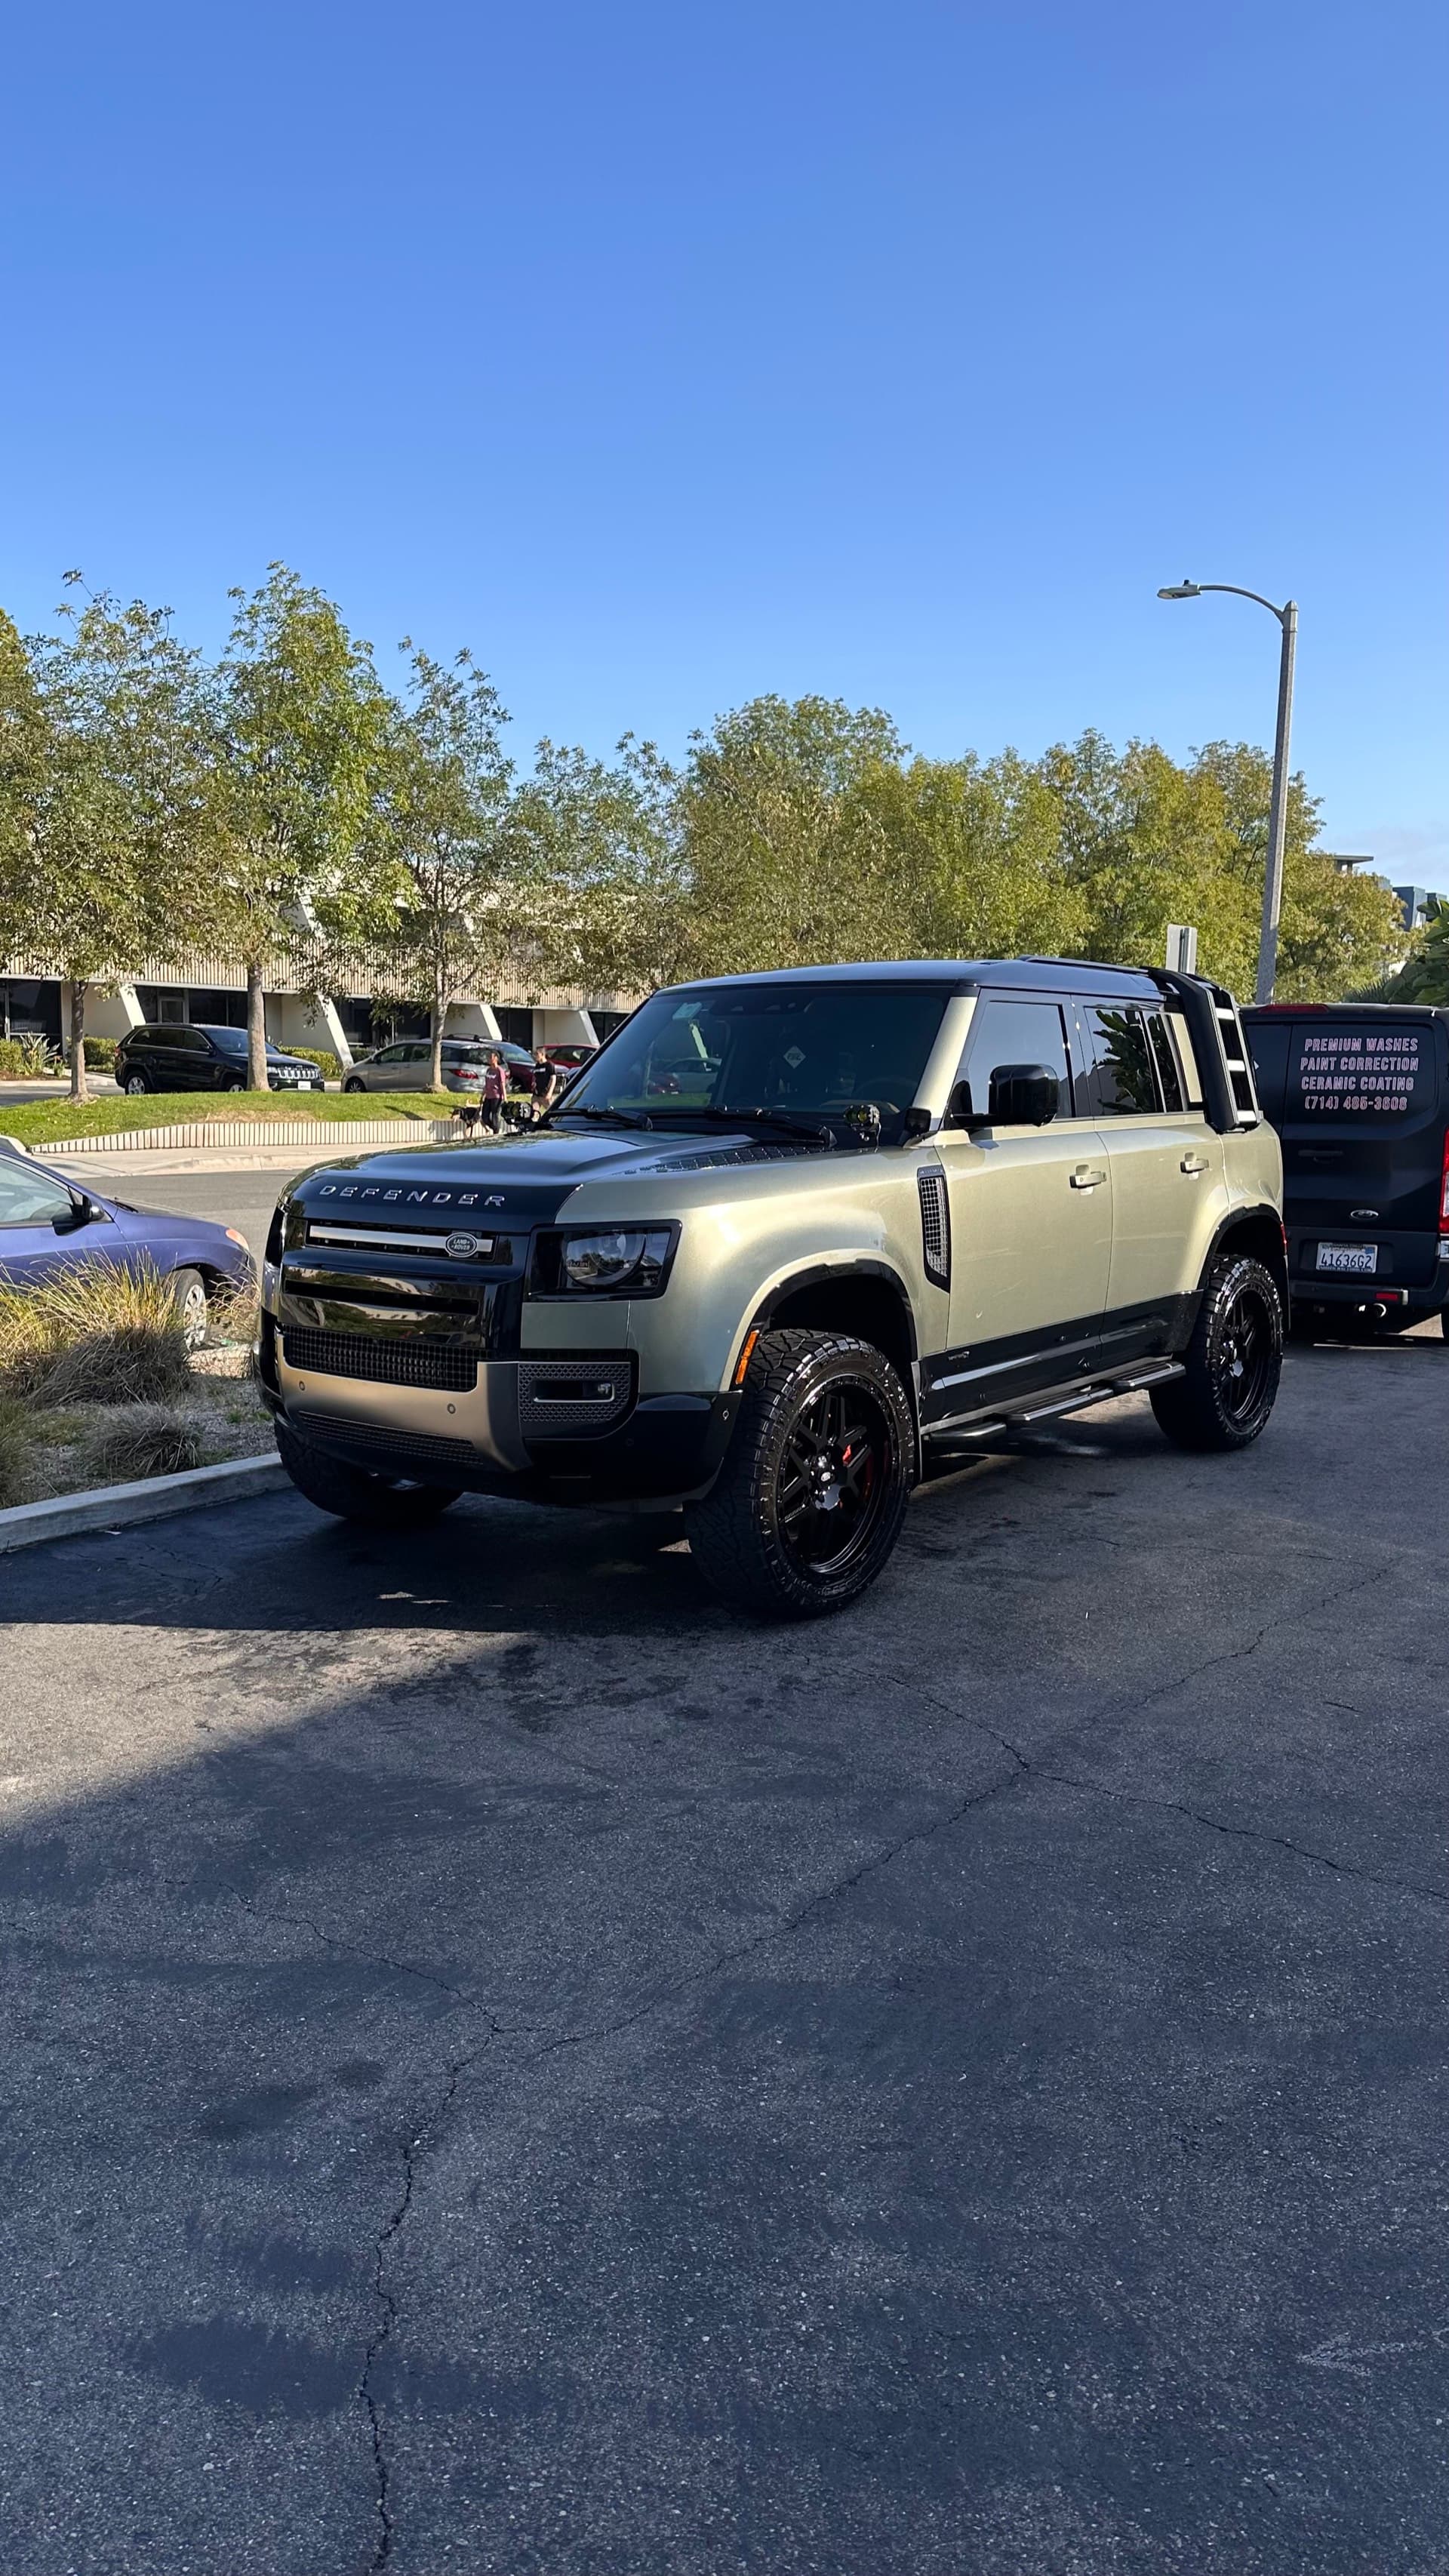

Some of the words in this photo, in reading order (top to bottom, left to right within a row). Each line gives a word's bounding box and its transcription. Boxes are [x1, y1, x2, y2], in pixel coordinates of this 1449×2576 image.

[1304, 1038, 1361, 1051] PREMIUM
[1366, 1038, 1418, 1051] WASHES
[1300, 1057, 1337, 1071] PAINT
[1340, 1057, 1419, 1071] CORRECTION
[1301, 1076, 1356, 1091] CERAMIC
[1360, 1076, 1414, 1091] COATING
[1305, 1096, 1339, 1110] (714)
[318, 1185, 506, 1208] DEFENDER
[1321, 1253, 1372, 1269] 41636G2
